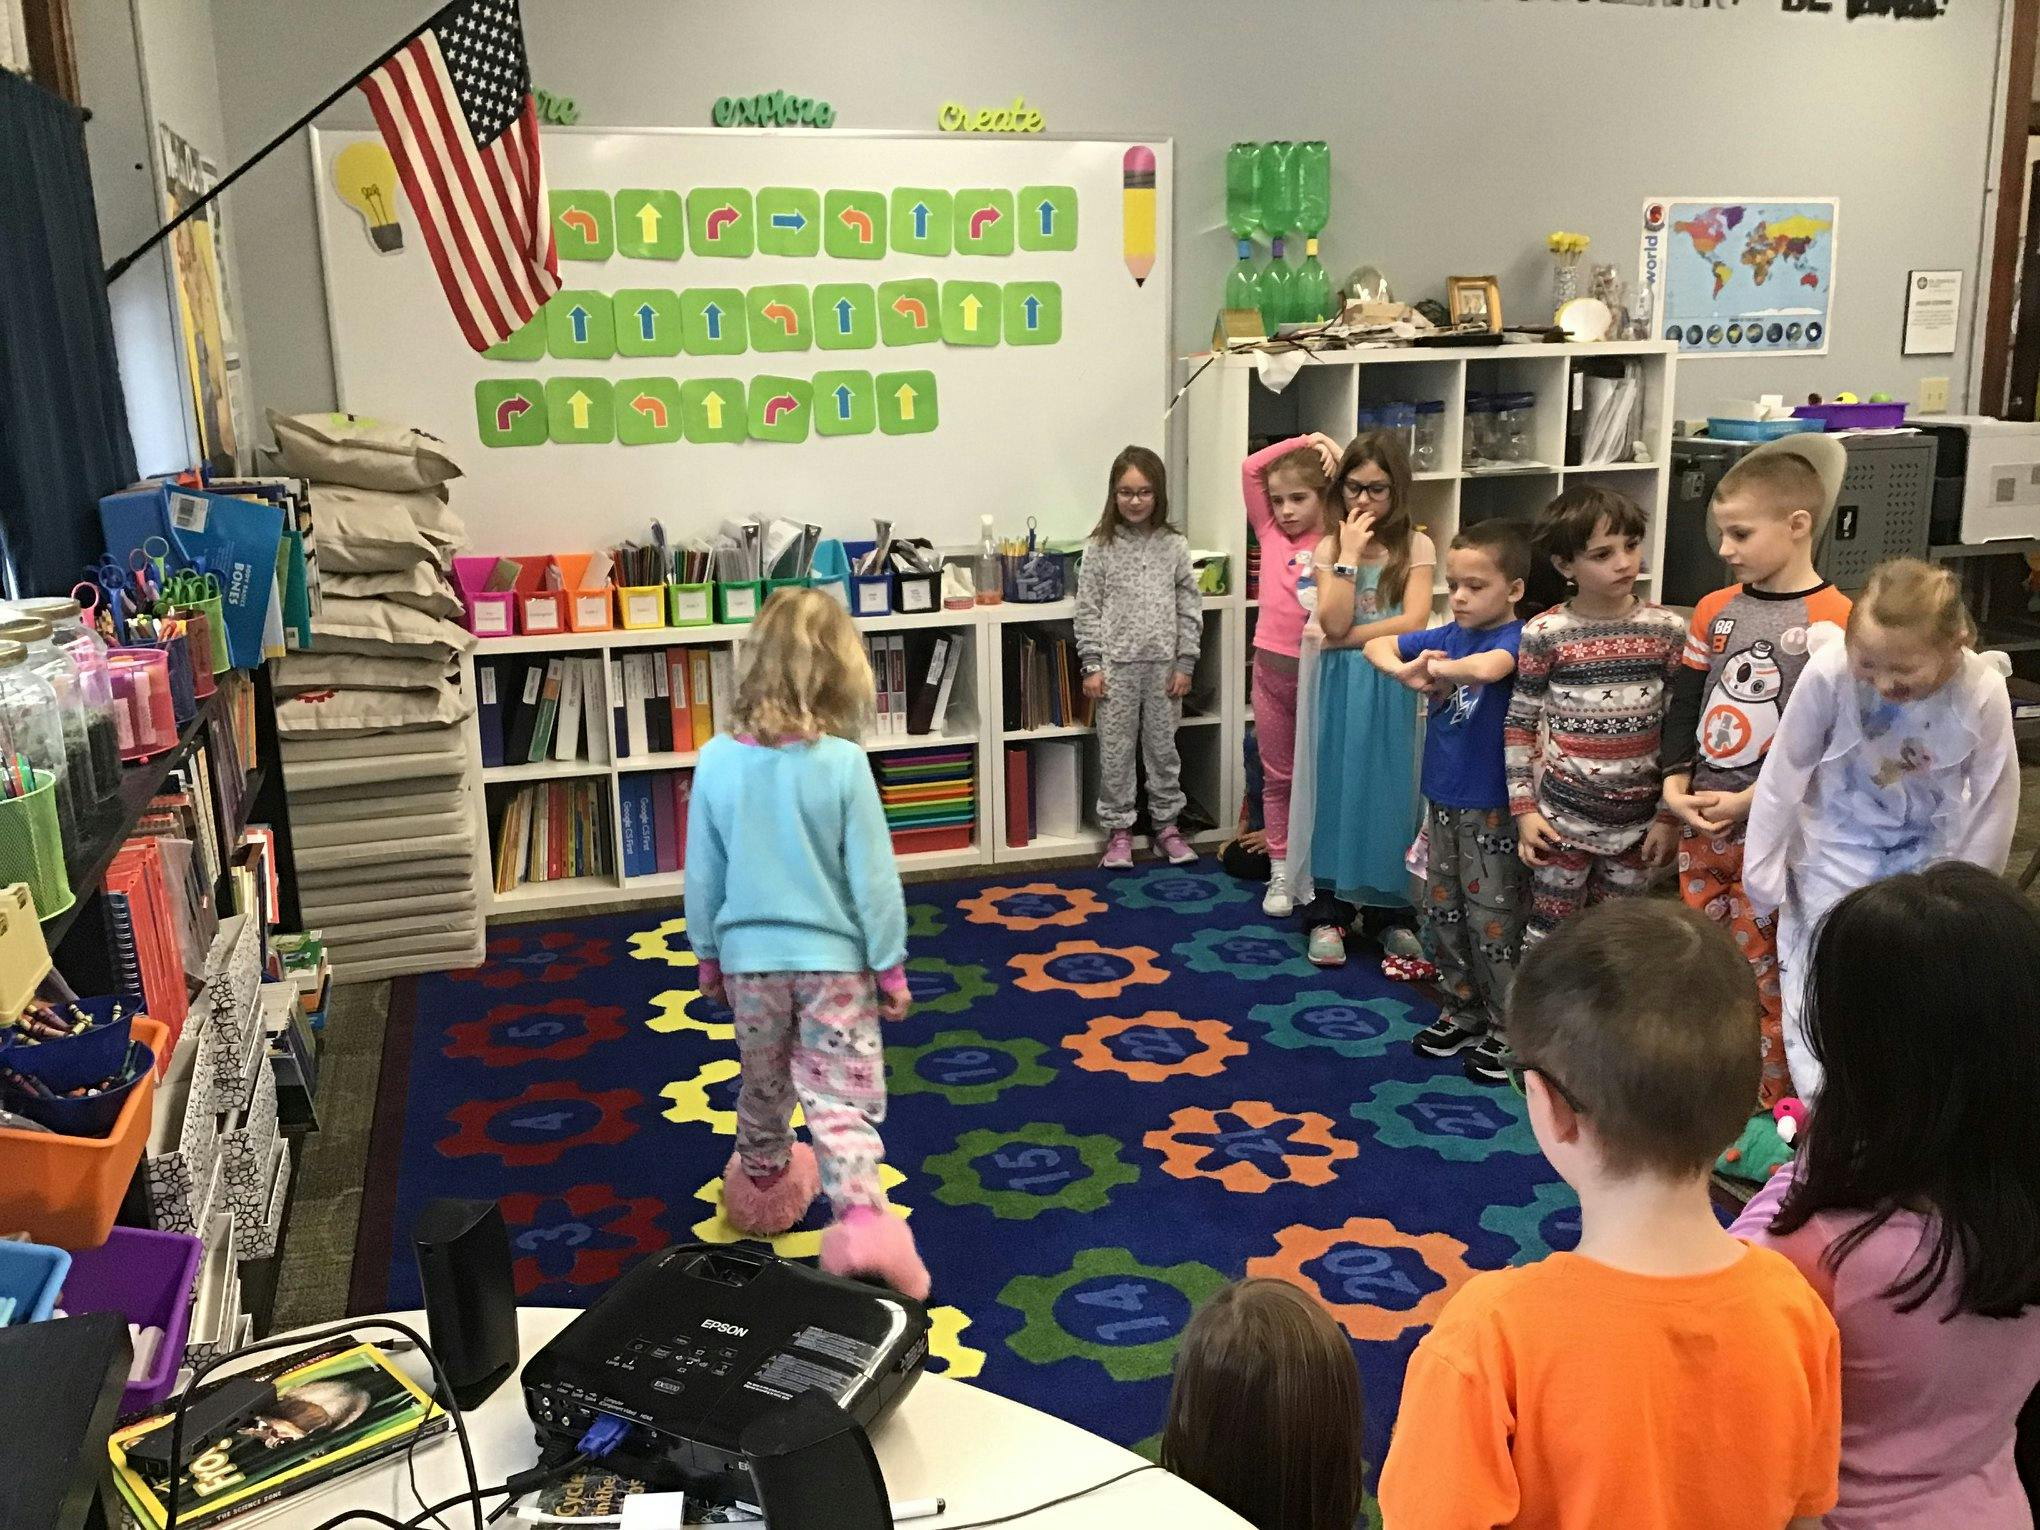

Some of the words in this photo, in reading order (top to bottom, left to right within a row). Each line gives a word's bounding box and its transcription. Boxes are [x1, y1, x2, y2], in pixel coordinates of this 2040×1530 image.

[1644, 234, 1660, 286] world
[229, 562, 245, 605] BONES
[1714, 619, 1735, 635] BB
[622, 800, 634, 828] Google
[638, 796, 650, 824] Google
[1302, 1007, 1377, 1038] 28
[932, 1048, 998, 1084] 16
[510, 1110, 575, 1131] 4
[993, 1147, 1071, 1190] 15
[514, 1221, 594, 1251] 3
[1321, 1249, 1421, 1300] 20
[1074, 1282, 1170, 1341] 14
[700, 1318, 750, 1338] EPSON
[215, 1509, 232, 1521] THE
[232, 1499, 262, 1517] SCIENCE
